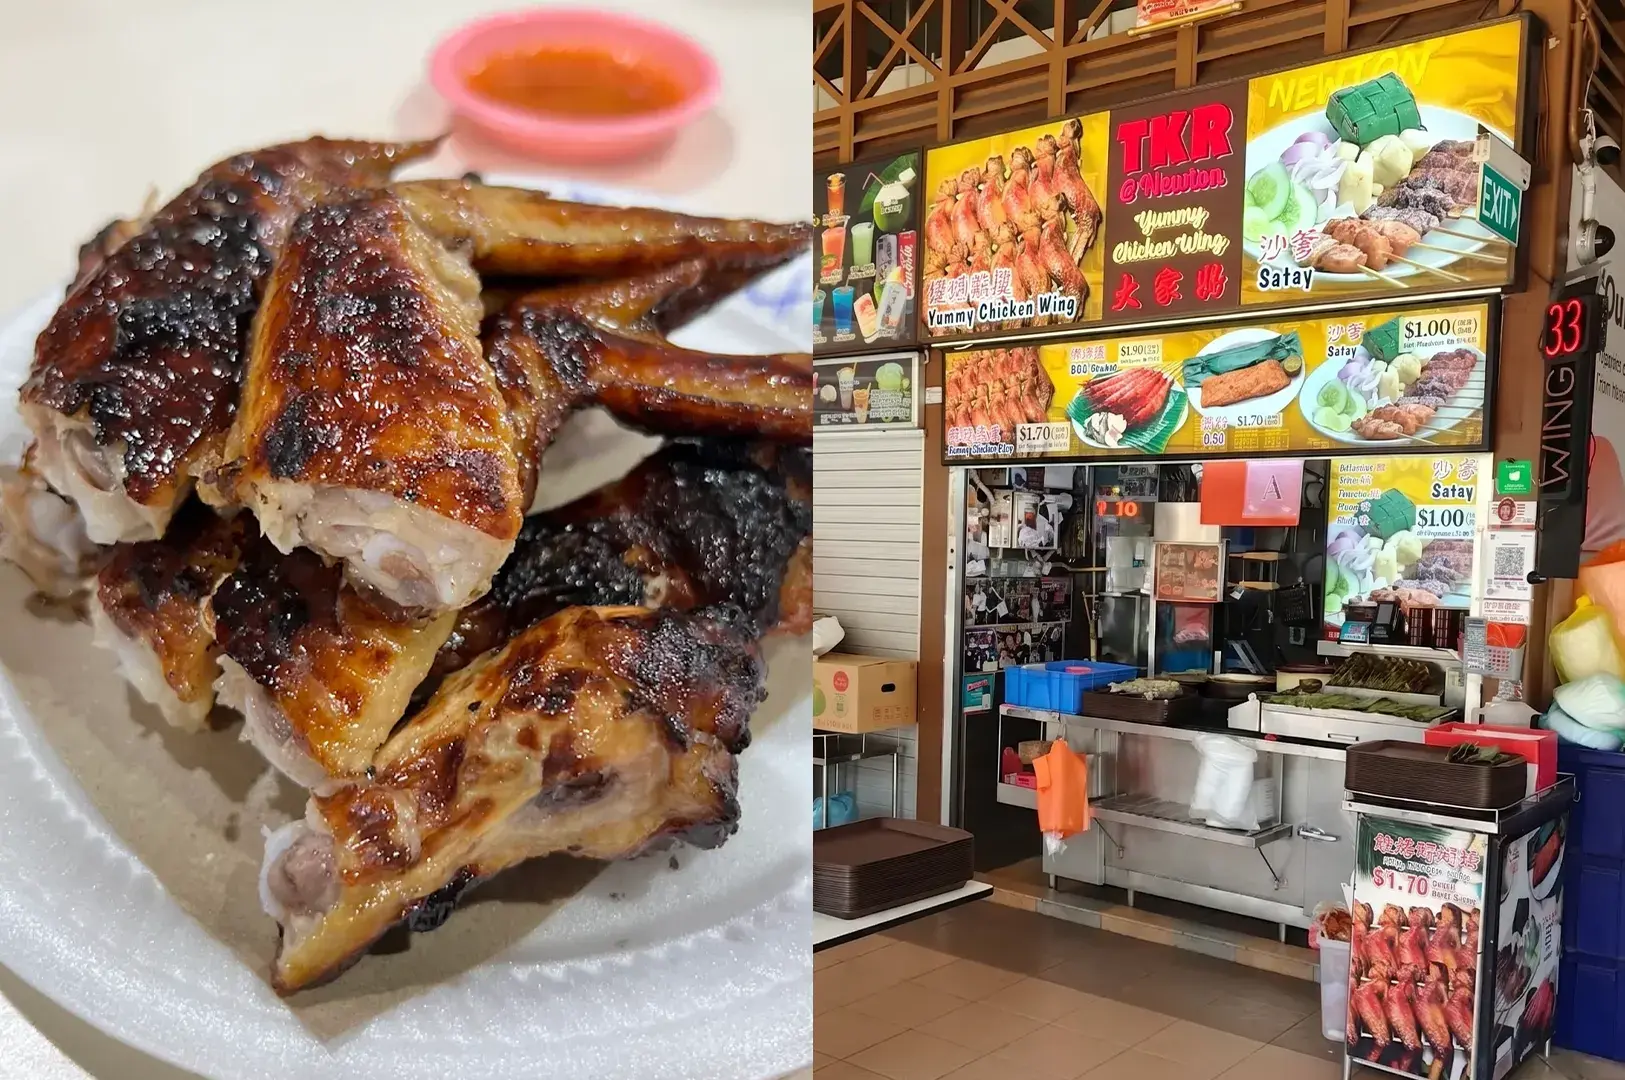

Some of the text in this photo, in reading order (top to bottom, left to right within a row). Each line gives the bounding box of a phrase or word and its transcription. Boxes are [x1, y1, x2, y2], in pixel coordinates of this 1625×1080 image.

[1117, 103, 1233, 175] TKR
[1482, 175, 1511, 228] EXIT
[1134, 206, 1209, 235] Yummy
[1112, 233, 1229, 264] Chicken Wing
[1259, 267, 1312, 289] Satay
[928, 295, 1075, 326] Yummy Chicken Wing
[1404, 318, 1451, 341] $1.00
[1546, 299, 1582, 356] 33
[1328, 346, 1357, 359] Satay
[1020, 426, 1050, 442] $1.70
[1539, 367, 1575, 487] WING
[1262, 474, 1282, 500] A
[1432, 483, 1474, 501] Satay
[1418, 508, 1465, 528] $1.00
[1373, 866, 1428, 896] $1.70
